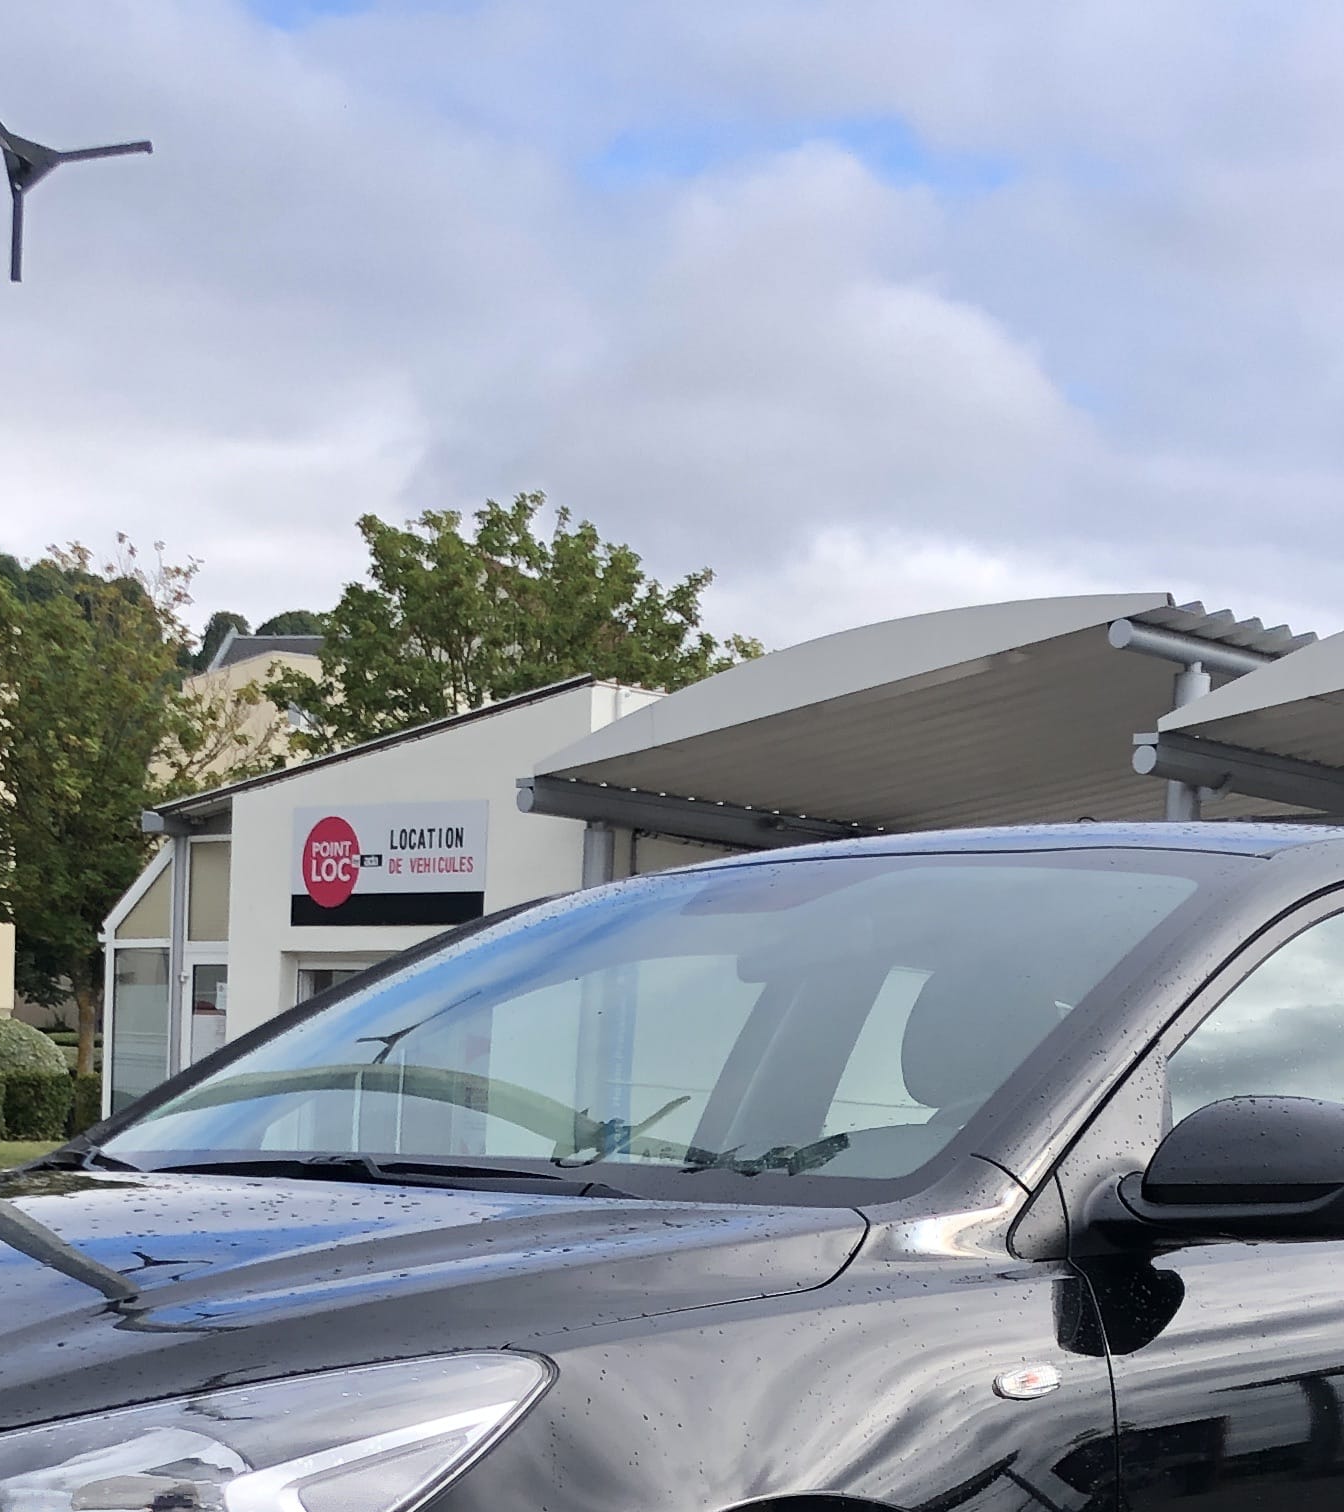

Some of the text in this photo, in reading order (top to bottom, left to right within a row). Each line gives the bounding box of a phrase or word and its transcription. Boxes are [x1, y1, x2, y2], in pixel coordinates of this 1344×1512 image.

[390, 827, 464, 850] LOCATION
[311, 840, 352, 858] POINT
[311, 858, 352, 882] LOC
[388, 858, 403, 874] DE
[410, 856, 474, 873] VEHICULES
